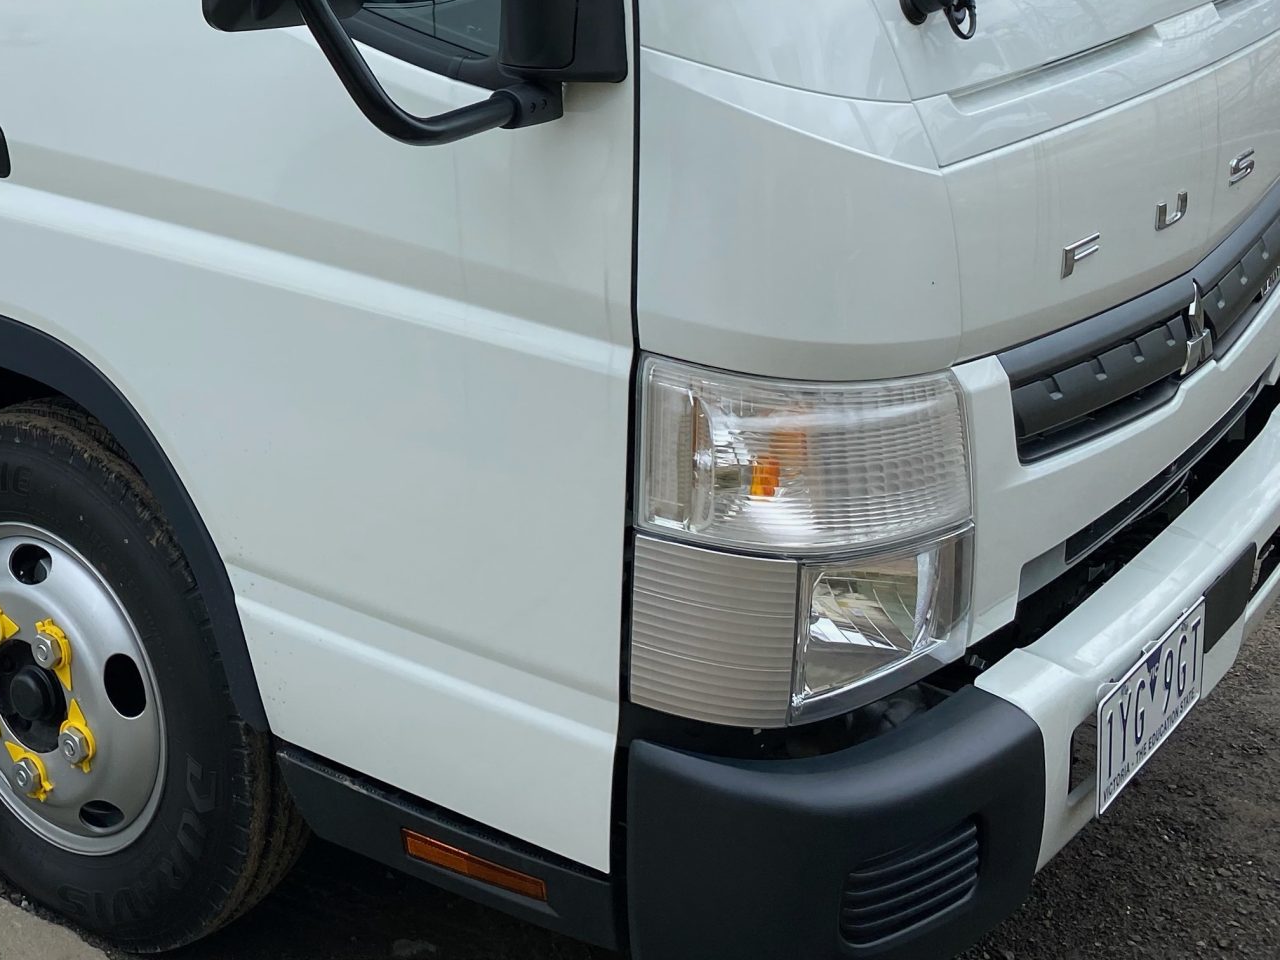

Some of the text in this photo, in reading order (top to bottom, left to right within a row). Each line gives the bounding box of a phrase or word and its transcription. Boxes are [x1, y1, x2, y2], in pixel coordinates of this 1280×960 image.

[1103, 762, 1130, 803] VICTORIA
[1136, 741, 1148, 763] THE
[1148, 709, 1180, 751] EDUCATION
[1179, 686, 1195, 714] STATE
[1106, 677, 1146, 779] 1YG
[1162, 616, 1201, 716] 9GT
